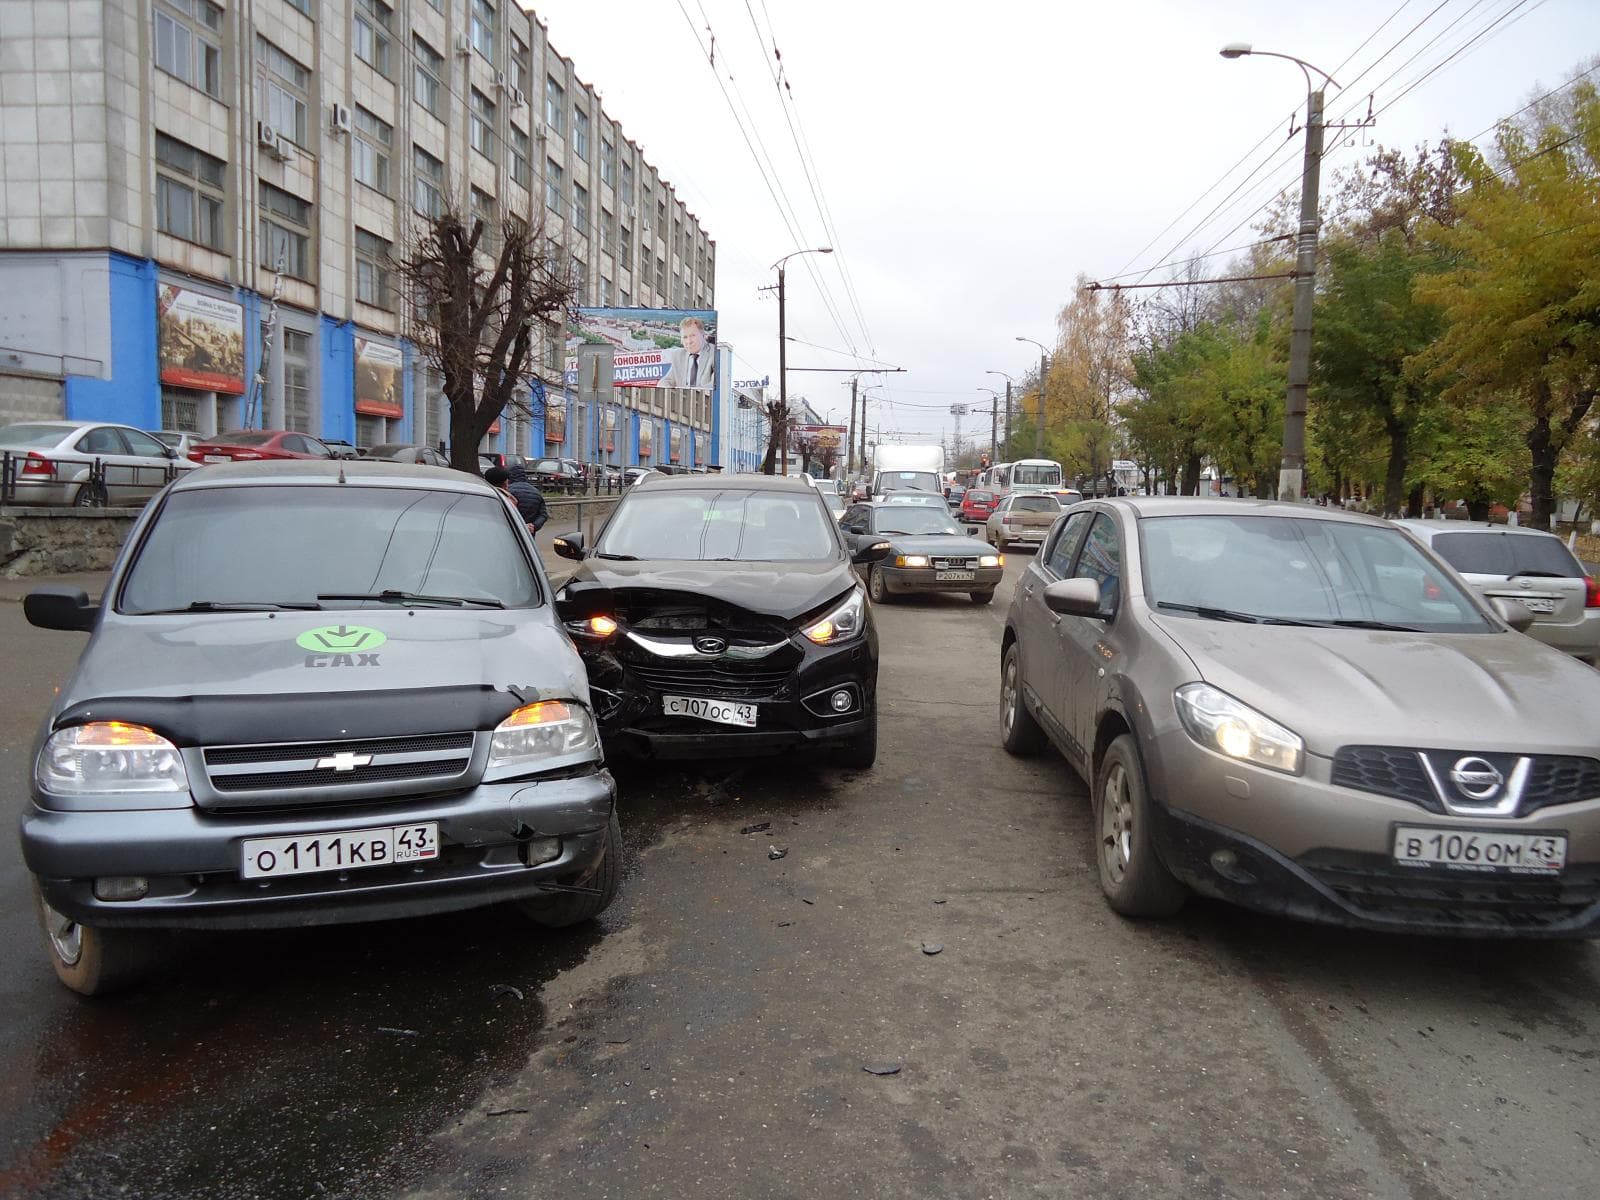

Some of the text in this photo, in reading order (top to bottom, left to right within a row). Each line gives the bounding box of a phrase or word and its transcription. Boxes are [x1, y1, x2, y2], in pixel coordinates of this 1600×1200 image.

[613, 366, 662, 380] АДЁЖНО!
[304, 653, 380, 667] САХ
[670, 699, 752, 720] С707ОС 43
[257, 827, 427, 872] О111КВ 43
[396, 849, 419, 859] RUS
[1406, 834, 1521, 864] В106ОМ
[1528, 839, 1555, 859] 43
